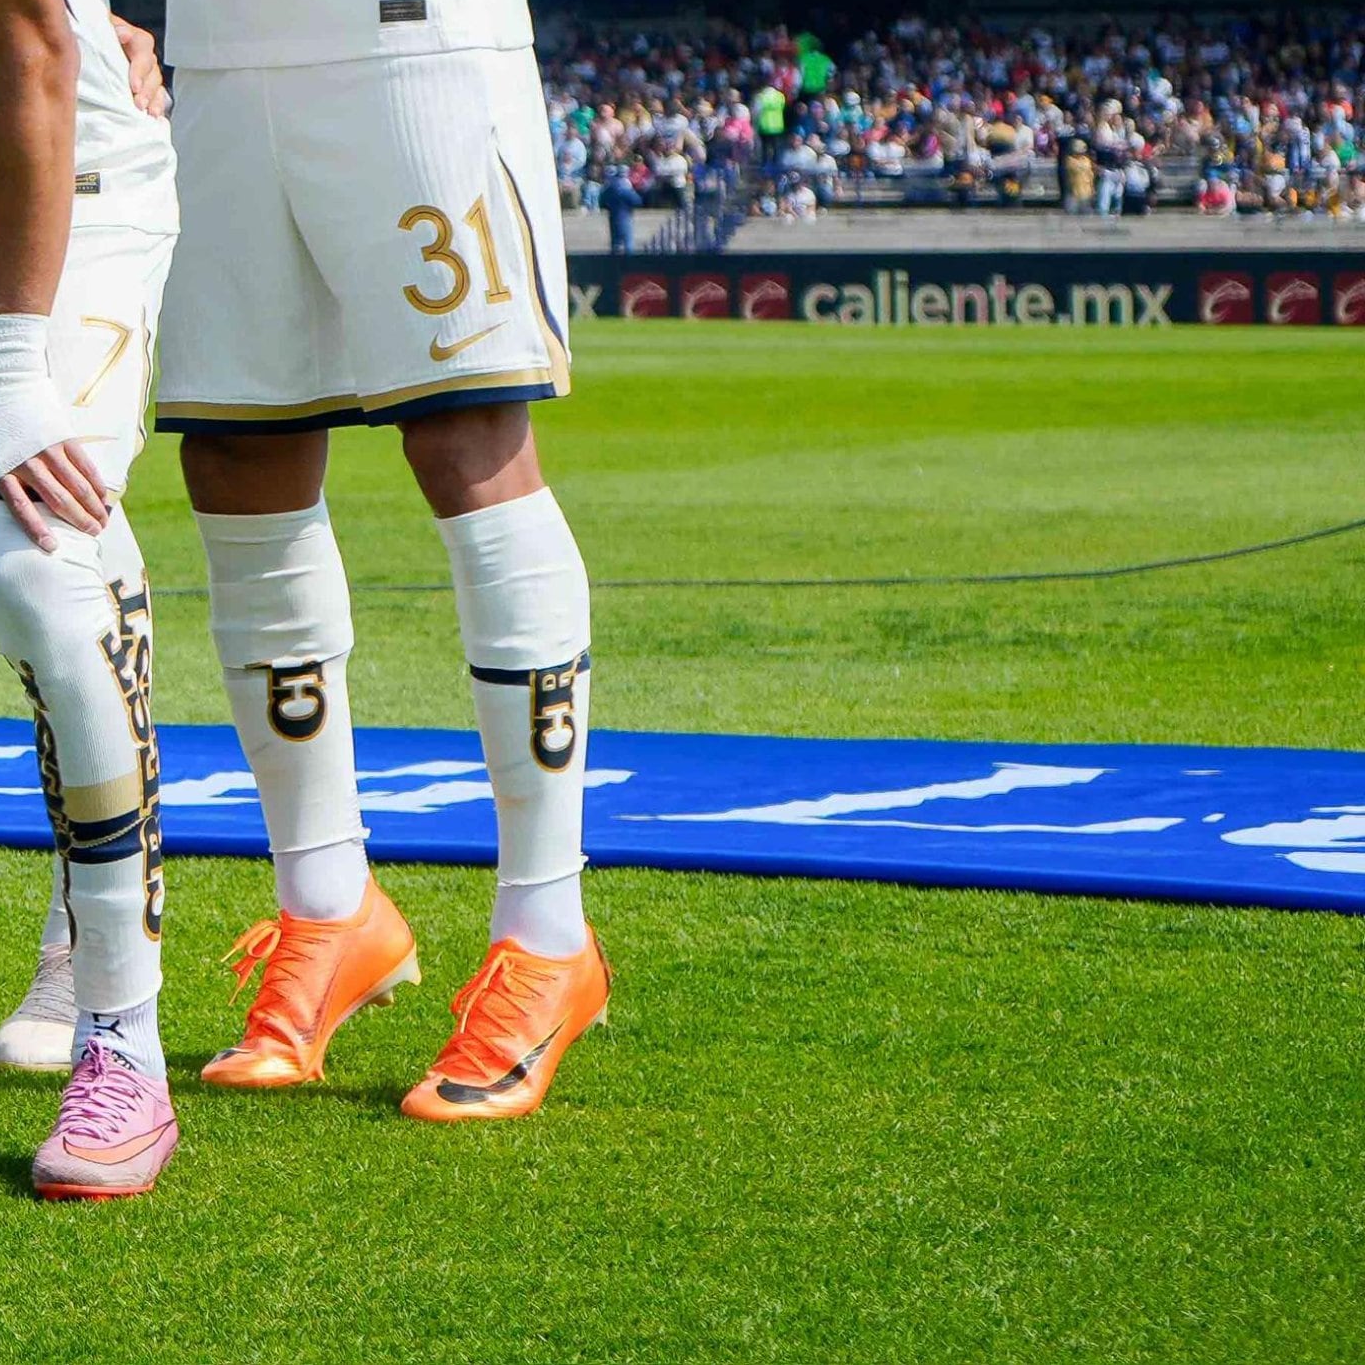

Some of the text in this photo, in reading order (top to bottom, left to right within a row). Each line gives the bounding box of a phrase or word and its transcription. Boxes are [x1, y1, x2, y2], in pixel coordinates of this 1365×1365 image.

[397, 195, 512, 316] 31
[802, 269, 1174, 327] caliente.mx
[72, 315, 133, 407] 7
